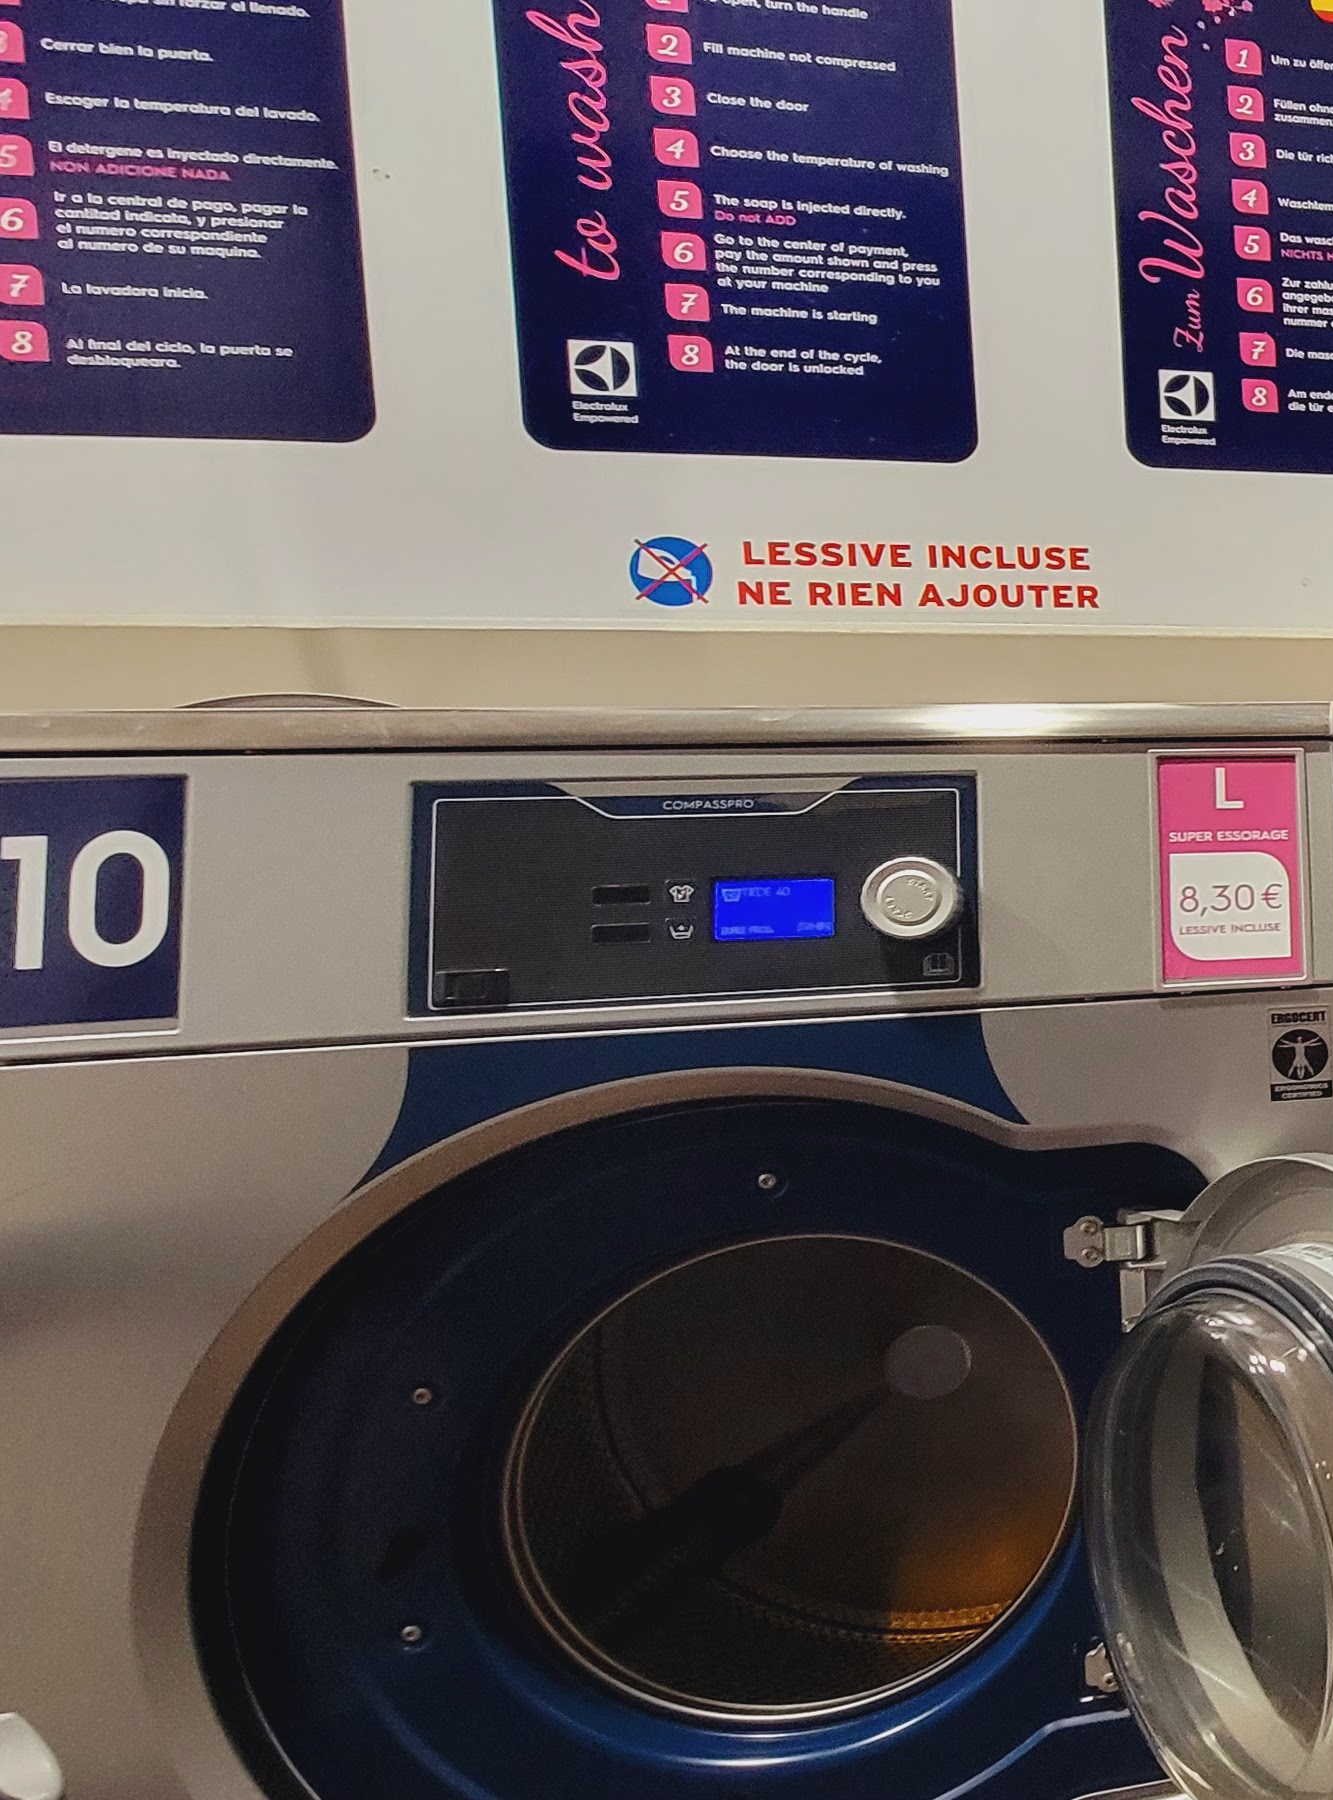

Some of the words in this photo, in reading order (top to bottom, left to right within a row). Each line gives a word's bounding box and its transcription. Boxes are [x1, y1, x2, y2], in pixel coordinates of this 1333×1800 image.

[39, 37, 95, 53] Cerrar
[97, 42, 135, 56] bien
[136, 44, 154, 58] la
[156, 48, 214, 62] puerta.
[657, 34, 679, 57] 2
[701, 41, 724, 54] Fill
[725, 46, 786, 61] machine
[787, 52, 813, 63] not
[813, 55, 896, 72] compressed
[1235, 49, 1248, 68] 1
[525, 0, 613, 190] wash
[662, 86, 682, 108] 3
[705, 92, 746, 107] Close
[748, 96, 773, 109] the
[774, 99, 809, 112] door
[1235, 95, 1254, 115] 2
[1272, 98, 1307, 112] Füllen
[0, 144, 18, 168] 5
[666, 139, 685, 160] 4
[1130, 24, 1206, 284] Waschen
[1239, 141, 1255, 161] 3
[1274, 148, 1296, 161] Die
[1296, 151, 1314, 162] tür
[708, 145, 763, 160] Choose
[765, 150, 789, 162] the
[791, 152, 876, 170] temperature
[877, 160, 893, 171] of
[895, 163, 949, 178] washing
[669, 190, 690, 211] 5
[712, 193, 740, 207] The
[742, 198, 779, 211] soap
[780, 199, 794, 211] is
[795, 200, 851, 215] injected
[852, 205, 906, 220] directly.
[1241, 189, 1257, 208] 4
[0, 207, 24, 231] 6
[713, 209, 735, 222] Do
[737, 213, 762, 224] not
[764, 214, 797, 226] ADD
[554, 210, 621, 281] to
[712, 233, 735, 246] Go
[737, 235, 754, 247] to
[756, 236, 780, 249] the
[782, 240, 827, 251] center
[829, 241, 845, 253] of
[1243, 234, 1260, 254] 5
[1278, 231, 1303, 244] Das
[673, 241, 694, 263] 6
[713, 249, 742, 262] pay
[744, 249, 769, 262] the
[771, 253, 824, 265] amount
[825, 255, 870, 268] shown
[871, 259, 899, 270] and
[900, 262, 938, 273] press
[1279, 248, 1324, 261] NICHTS
[714, 261, 739, 274] the
[740, 264, 795, 277] number
[796, 269, 896, 286] corresponding
[897, 273, 913, 285] to
[914, 276, 940, 287] you
[716, 276, 733, 288] at
[734, 279, 768, 290] your
[770, 281, 829, 293] machine
[10, 274, 30, 298] 7
[60, 281, 83, 295] La
[84, 283, 159, 298] lavadora
[1246, 286, 1263, 306] 6
[681, 293, 698, 314] 7
[719, 303, 747, 316] The
[749, 307, 809, 319] machine
[811, 308, 824, 320] is
[825, 309, 878, 325] starting
[1172, 288, 1206, 353] Zum
[11, 331, 33, 354] 8
[723, 345, 741, 356] At
[742, 345, 767, 358] the
[768, 348, 797, 359] end
[799, 348, 815, 360] of
[817, 349, 840, 361] the
[1252, 340, 1267, 360] 7
[1284, 347, 1305, 359] Die
[681, 344, 699, 366] 8
[723, 358, 748, 371] the
[749, 360, 785, 372] door
[787, 361, 801, 373] is
[802, 363, 865, 376] unlocked
[1251, 387, 1267, 406] 8
[1286, 388, 1307, 399] Am
[742, 541, 913, 569] LESSIVE
[927, 543, 1090, 572] INCLUSE
[736, 580, 792, 607] NE
[807, 581, 903, 608] RIEN
[918, 582, 1099, 609] AJOUTER
[1215, 767, 1245, 809] L
[662, 799, 755, 811] COMPASSPRO
[1168, 831, 1213, 843] SUPER
[1216, 829, 1289, 842] ESSORAGE
[0, 829, 170, 971] 10
[1179, 884, 1255, 917] 8,30
[1260, 883, 1283, 909] €
[1179, 924, 1227, 936] LESSIVE
[1230, 922, 1281, 933] INCLUSE
